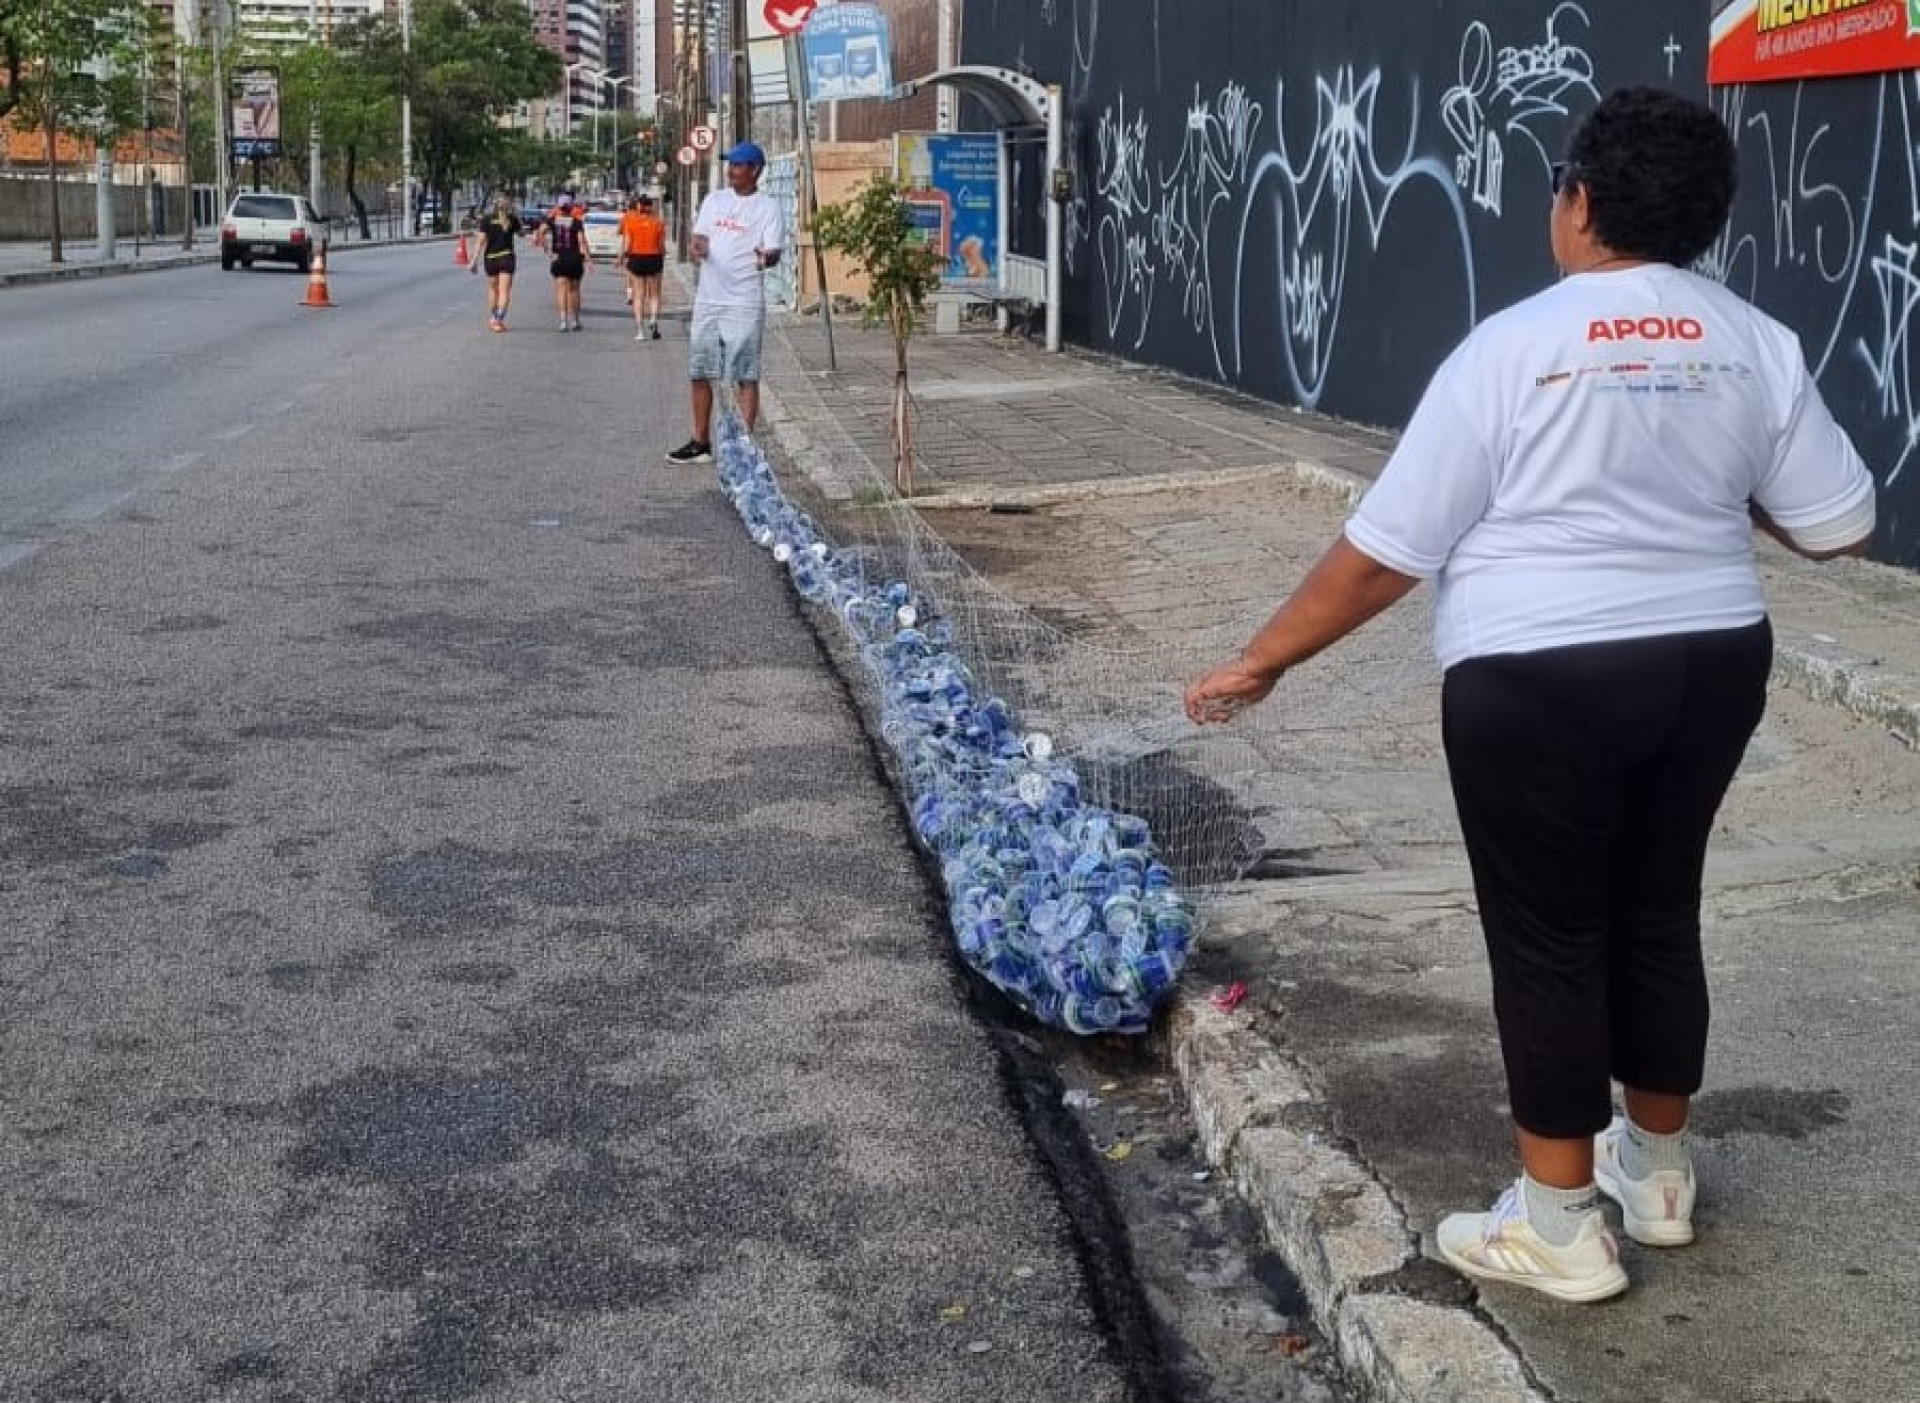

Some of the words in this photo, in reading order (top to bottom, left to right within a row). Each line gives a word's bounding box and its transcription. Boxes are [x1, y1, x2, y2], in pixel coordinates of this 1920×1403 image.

[1817, 19, 1835, 46] NO
[1837, 4, 1898, 41] MERCADO
[1587, 317, 1703, 342] APOIO
